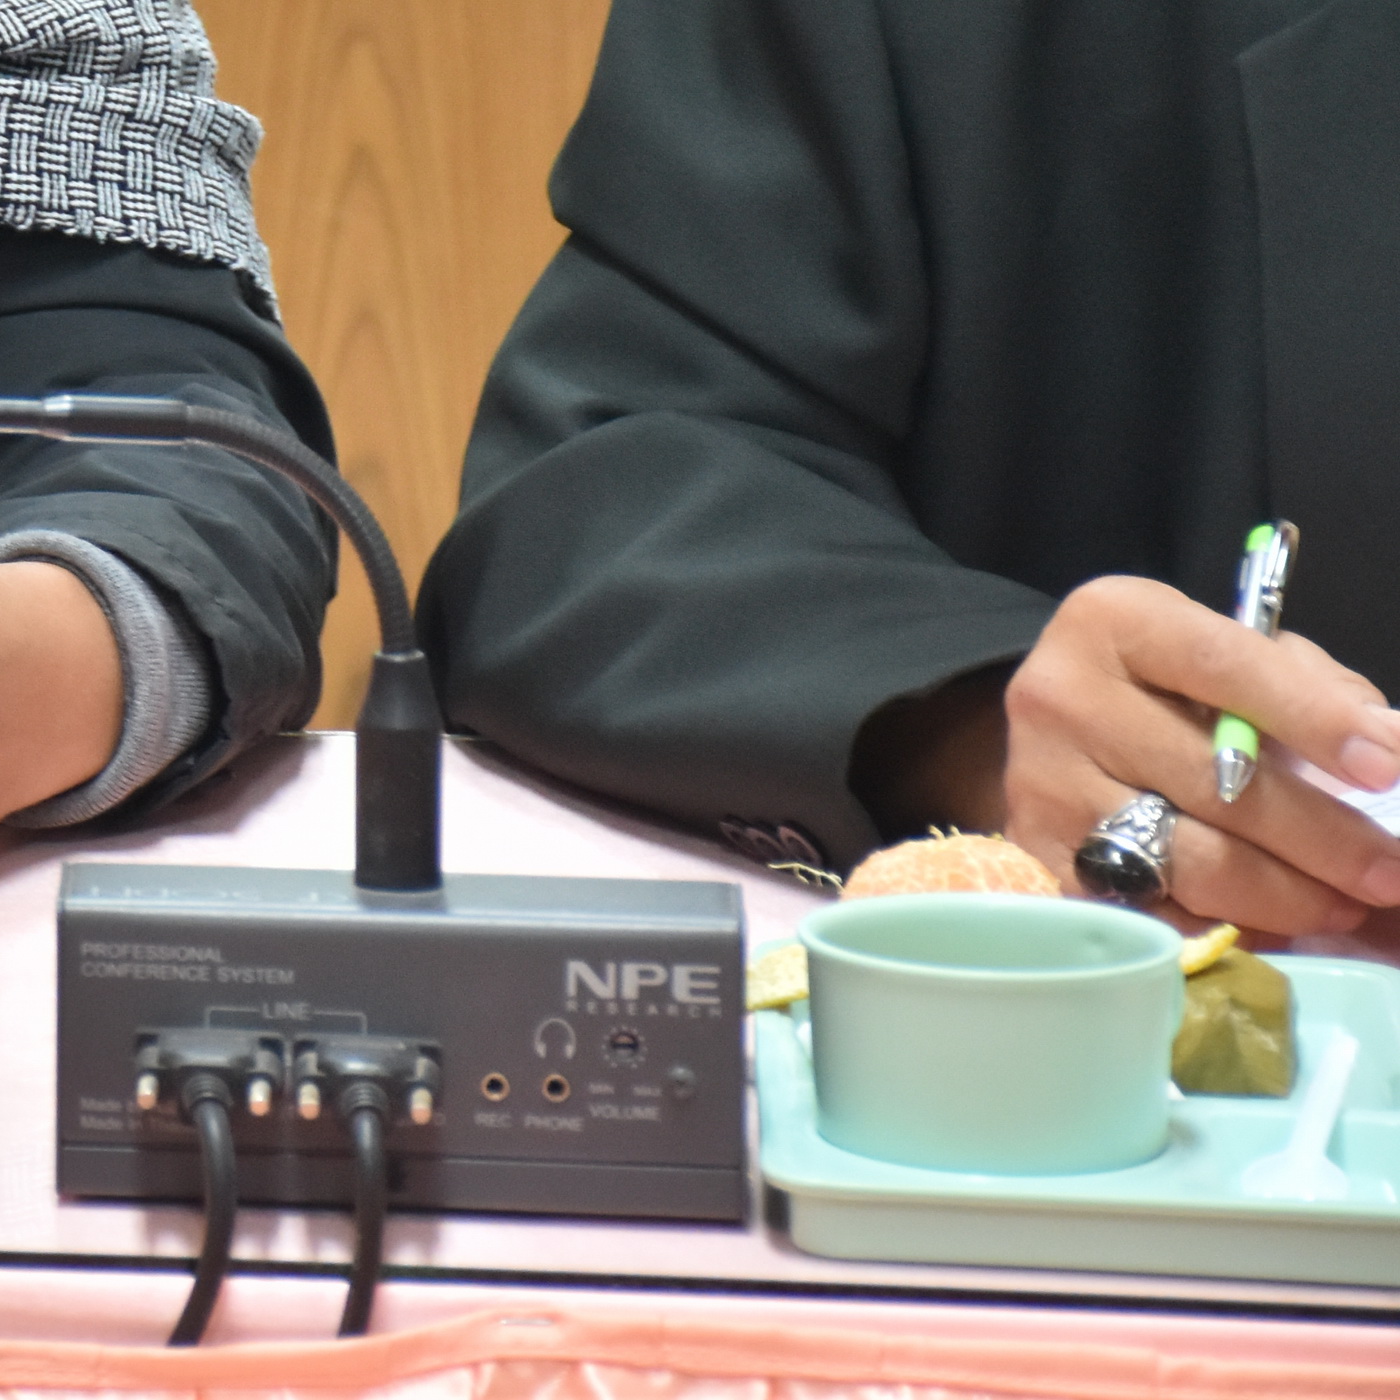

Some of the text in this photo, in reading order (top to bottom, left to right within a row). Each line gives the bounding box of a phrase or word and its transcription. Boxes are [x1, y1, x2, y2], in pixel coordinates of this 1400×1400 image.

[80, 942, 224, 963] PROFESSIONAL
[80, 961, 295, 985] CONFERENCE SYSTEM
[566, 960, 722, 1005] NPE
[262, 1002, 310, 1021] LINE
[566, 1000, 723, 1019] RESEARCH
[474, 1111, 512, 1129] REC
[523, 1113, 585, 1132] PHONE
[589, 1104, 661, 1122] VOLUME
